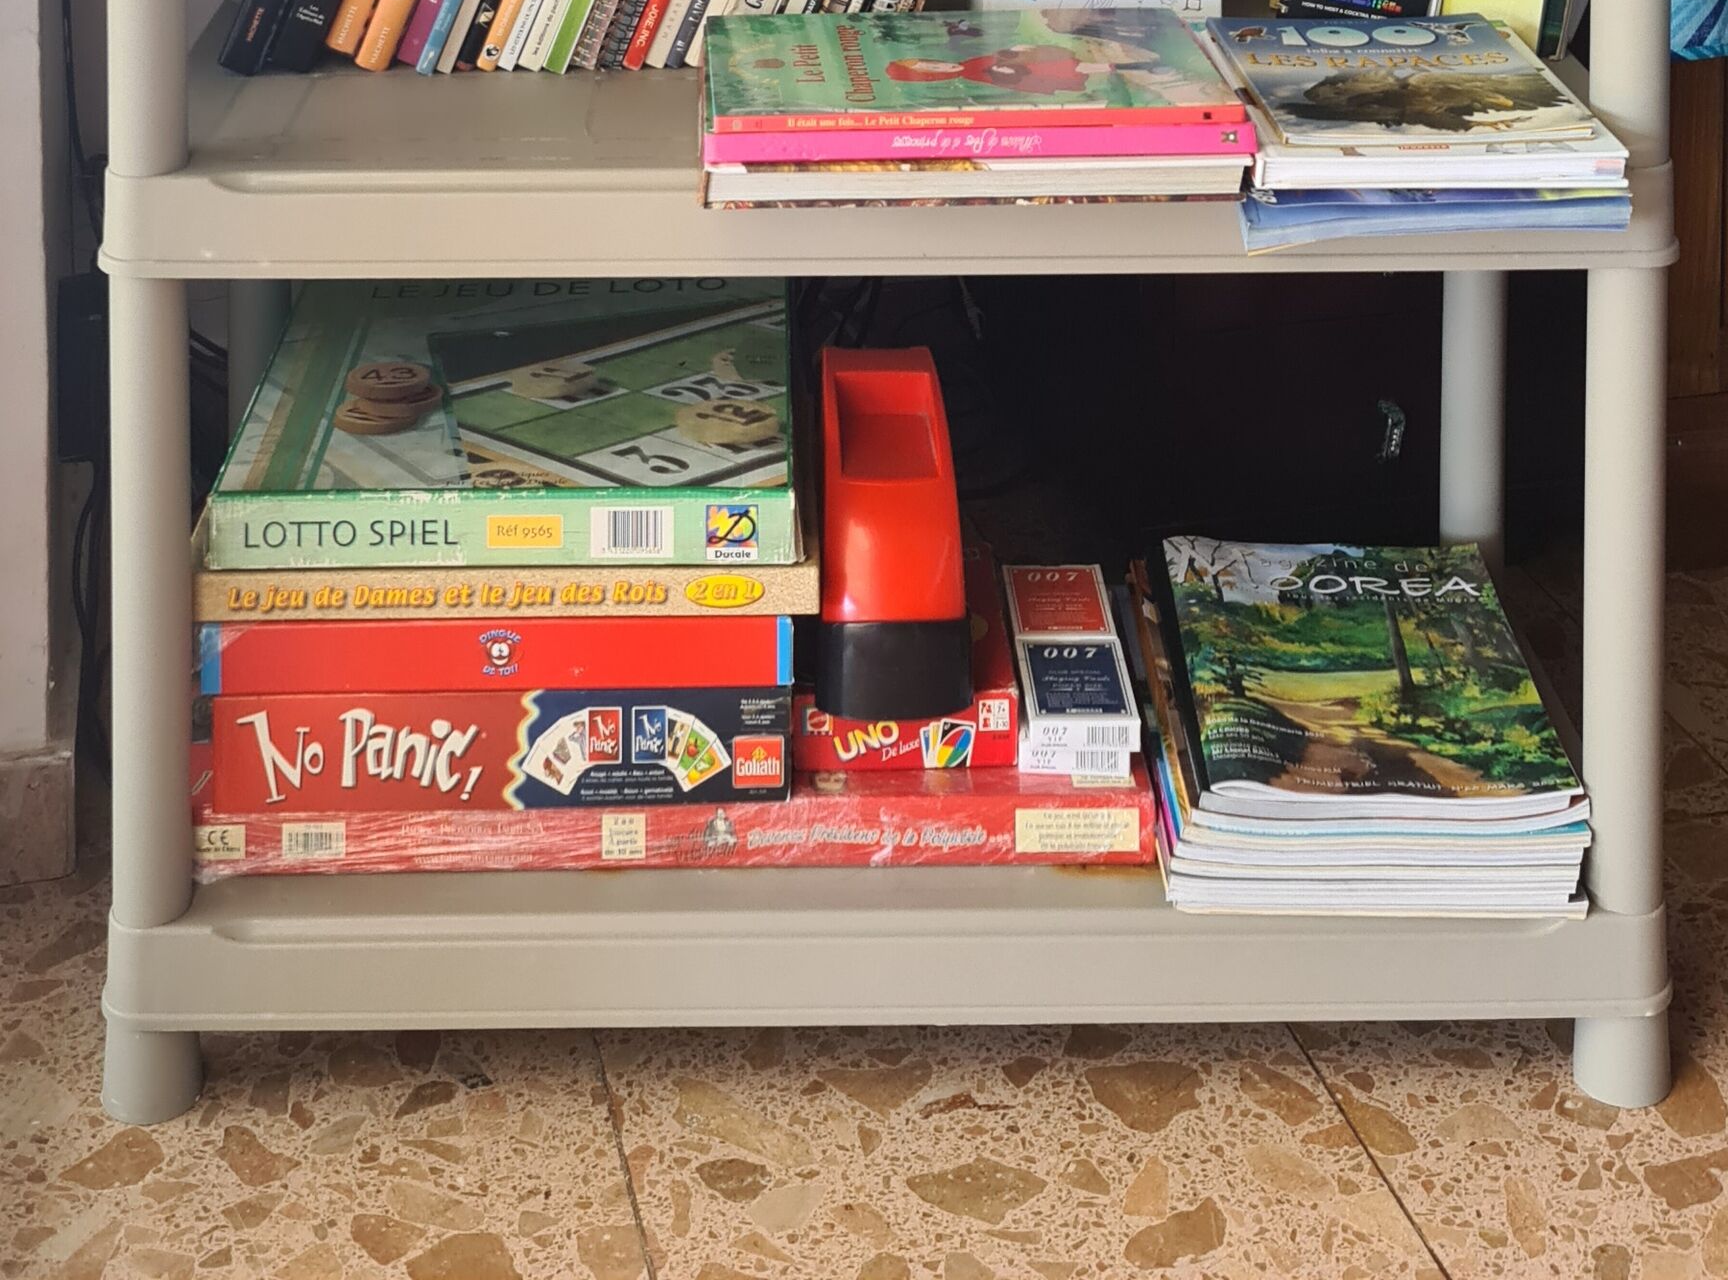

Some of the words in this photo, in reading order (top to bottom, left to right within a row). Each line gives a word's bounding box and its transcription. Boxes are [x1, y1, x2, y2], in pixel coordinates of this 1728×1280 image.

[840, 24, 869, 54] rouge
[795, 42, 826, 66] Petit
[1246, 51, 1319, 70] LES
[1325, 50, 1510, 70] RAPACES
[797, 67, 826, 86] Le
[843, 55, 877, 104] Chaperon
[371, 284, 420, 299] LE
[432, 282, 514, 298] JEU
[533, 280, 592, 296] DE
[607, 276, 728, 293] LOTO
[363, 365, 419, 383] 43
[243, 519, 357, 549] LOTTO
[368, 518, 459, 547] SPIEL
[496, 525, 519, 537] Réf
[522, 526, 554, 539] 9565
[713, 549, 752, 560] Ducale
[1026, 570, 1081, 583] 007
[228, 586, 257, 609] Le
[261, 585, 305, 611] jeu
[313, 585, 345, 608] de
[353, 583, 436, 606] Dames
[445, 585, 473, 606] et
[480, 583, 503, 605] le
[507, 583, 554, 608] jeu
[560, 582, 603, 604] des
[612, 580, 667, 604] Rois
[695, 581, 711, 600] 2
[714, 586, 739, 600] en
[742, 581, 755, 600] 1
[478, 628, 522, 644] DINGUE
[1043, 646, 1099, 660] 007
[592, 714, 616, 737] No
[639, 714, 662, 737] No
[1042, 726, 1068, 736] 007
[833, 720, 900, 762] UNO
[881, 746, 898, 762] De
[897, 739, 921, 758] luxe
[236, 709, 325, 803] No
[339, 708, 484, 802] Panic!
[736, 756, 780, 777] Goliath
